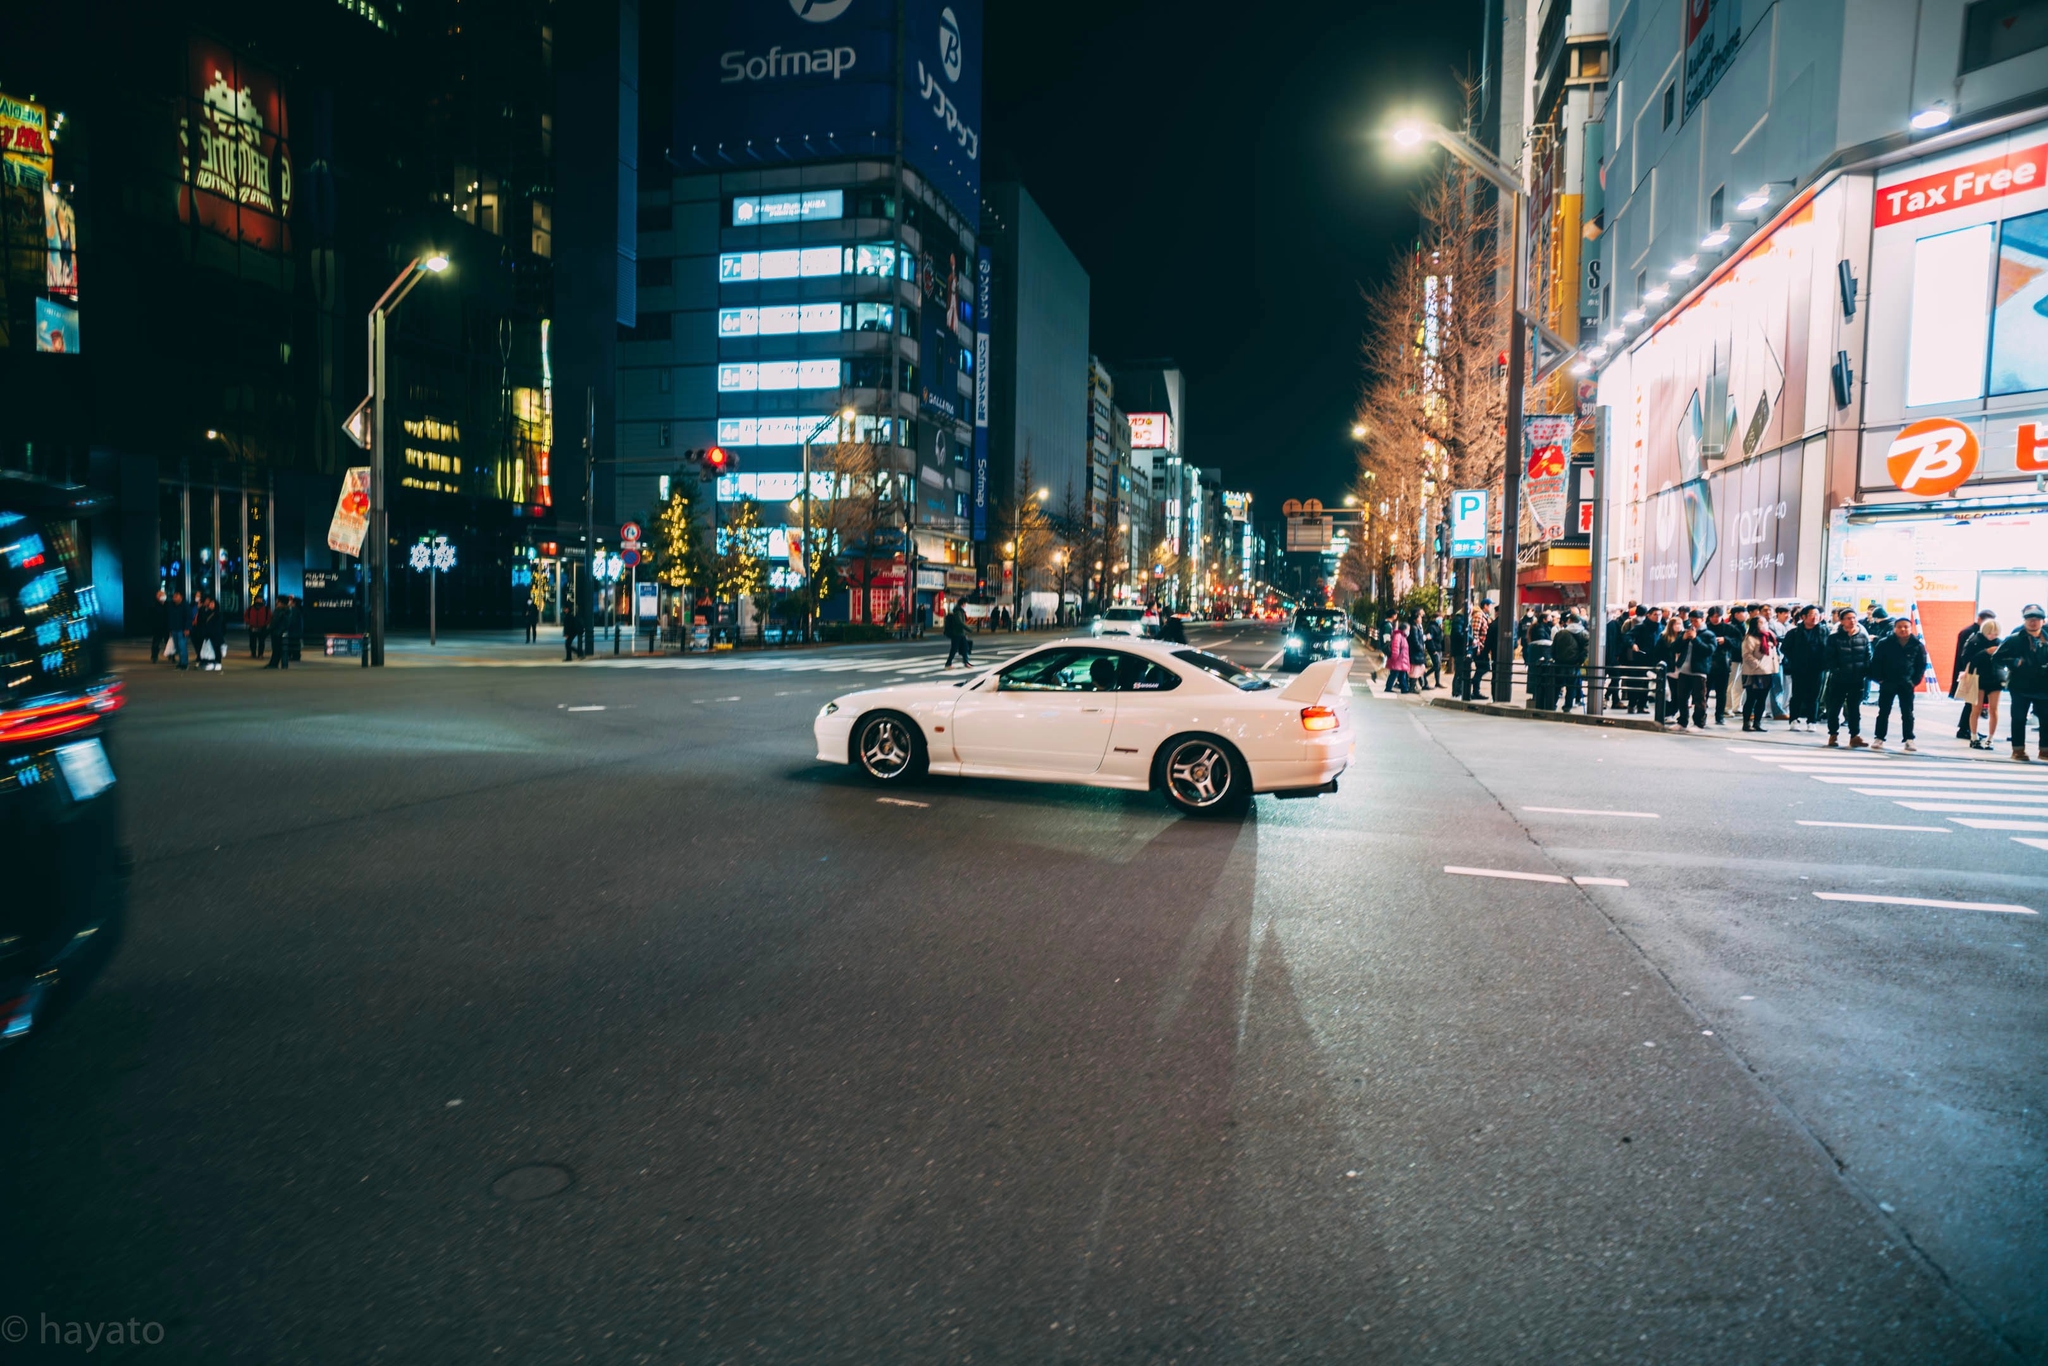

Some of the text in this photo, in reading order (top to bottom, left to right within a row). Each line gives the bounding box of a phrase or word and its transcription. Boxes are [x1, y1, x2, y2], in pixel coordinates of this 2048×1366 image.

[720, 46, 856, 83] Sofmap
[1886, 162, 2037, 216] Tax Free
[976, 458, 987, 508] Sofmap
[1460, 496, 1480, 520] P
[1731, 504, 1773, 547] razr
[1650, 560, 1678, 580] motorola
